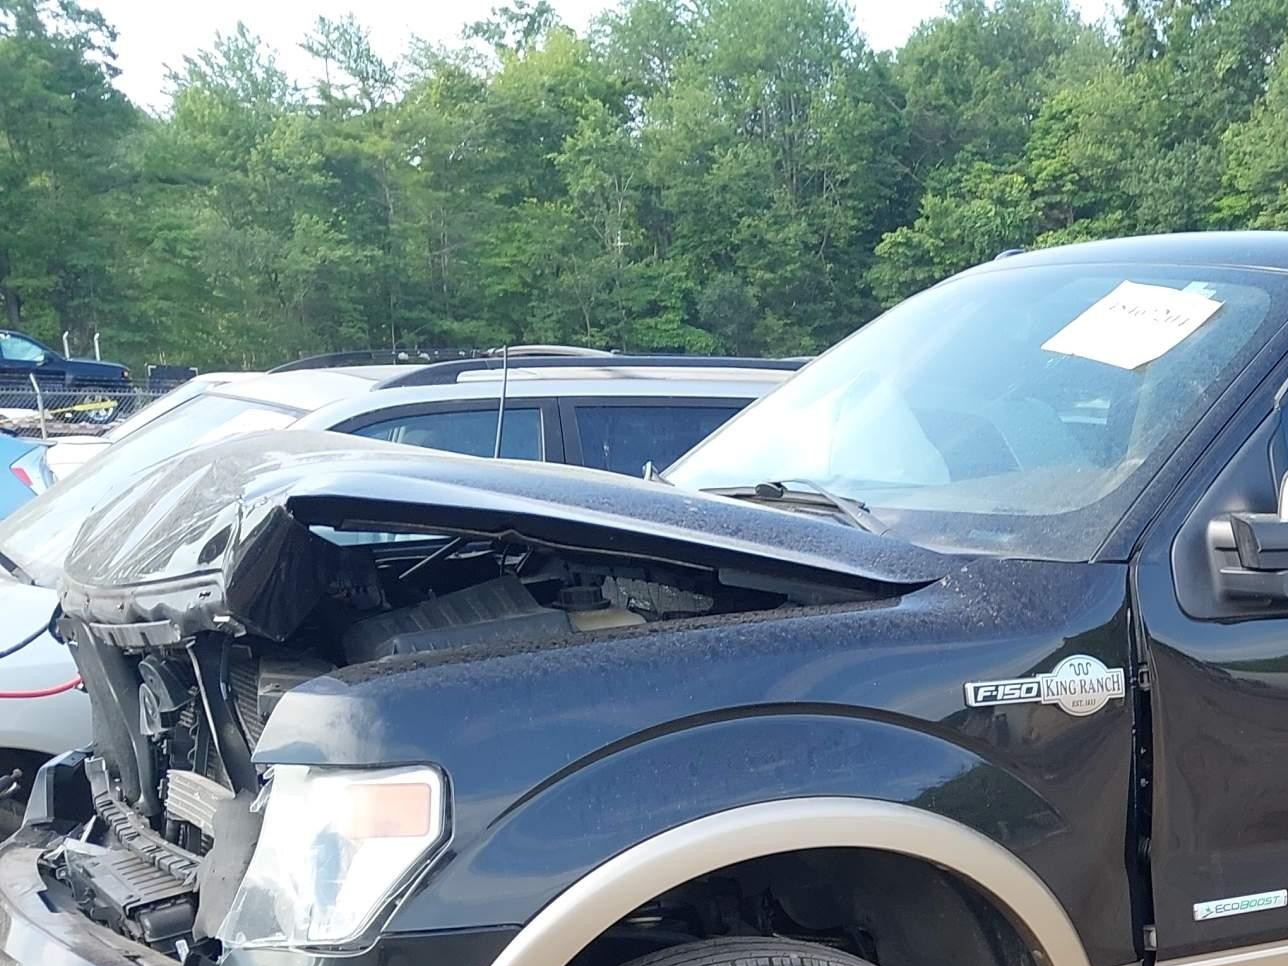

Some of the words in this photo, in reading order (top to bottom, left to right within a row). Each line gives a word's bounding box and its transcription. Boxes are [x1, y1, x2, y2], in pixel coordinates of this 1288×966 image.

[976, 682, 1039, 702] F-150
[1045, 678, 1077, 697] KING
[1080, 673, 1121, 695] RANCH
[1214, 895, 1281, 914] ECOBOOST
